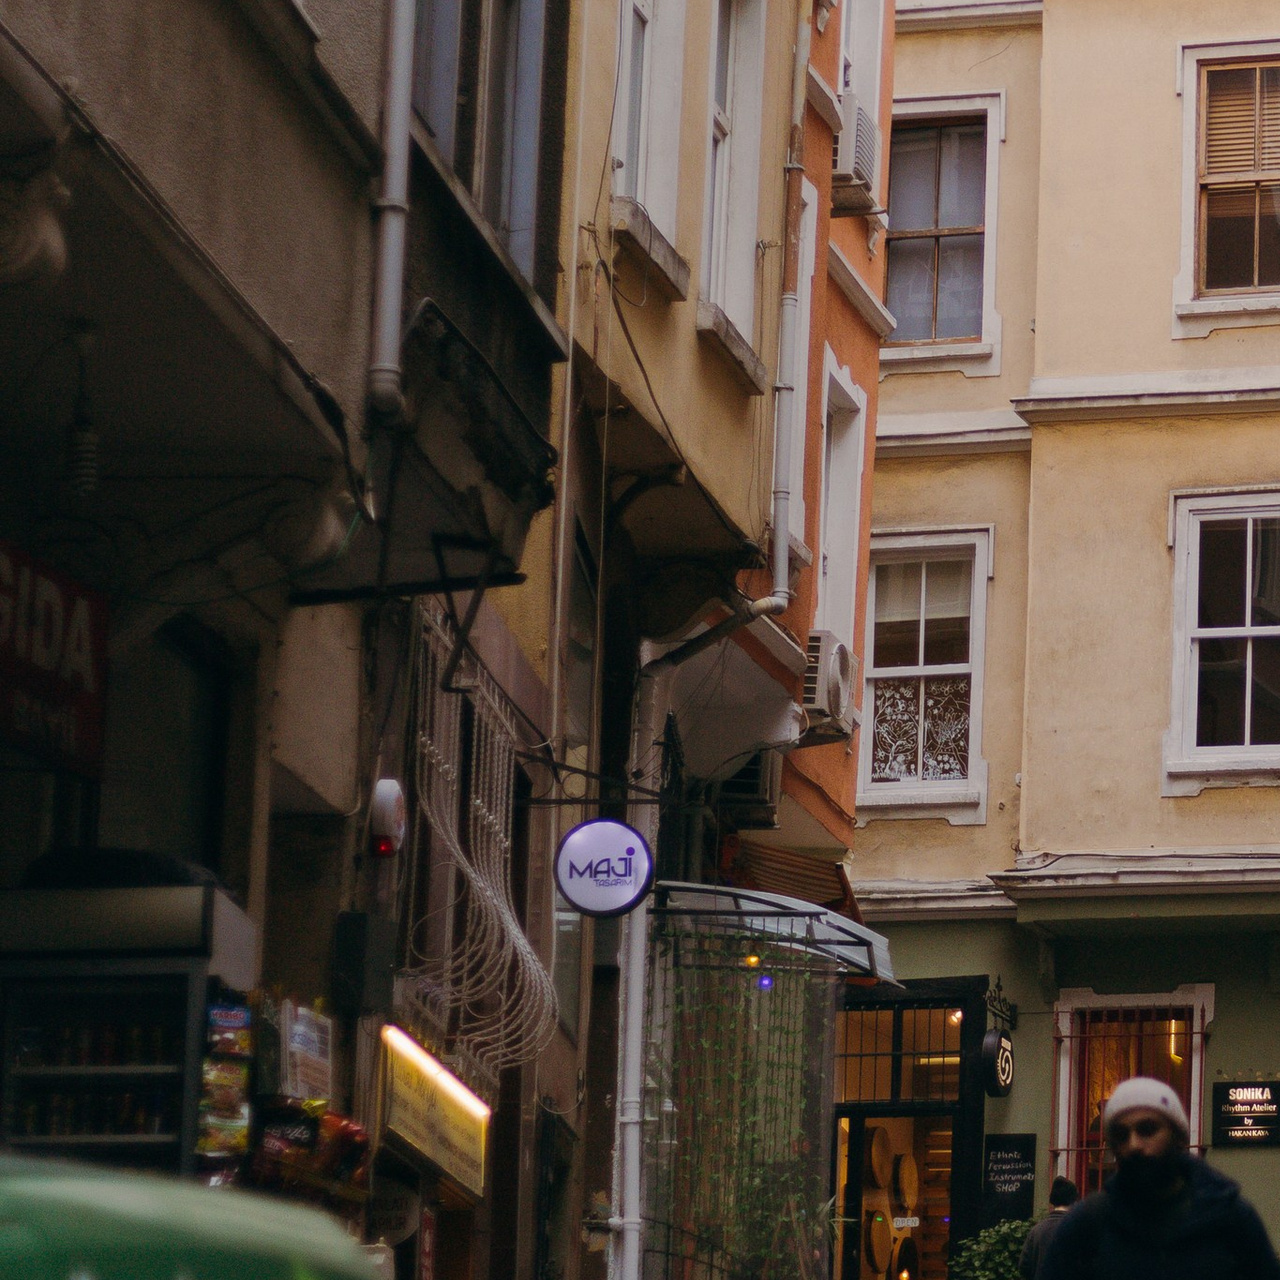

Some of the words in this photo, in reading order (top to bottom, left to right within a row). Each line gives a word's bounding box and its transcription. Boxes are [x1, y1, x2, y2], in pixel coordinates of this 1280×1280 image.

[1221, 1103, 1250, 1113] Rhythm
[1251, 1103, 1277, 1112] Atelier
[1244, 1117, 1254, 1126] by
[989, 1151, 1022, 1160] Ethnic
[995, 1182, 1020, 1192] SHOP
[895, 1218, 917, 1227] OPEN
